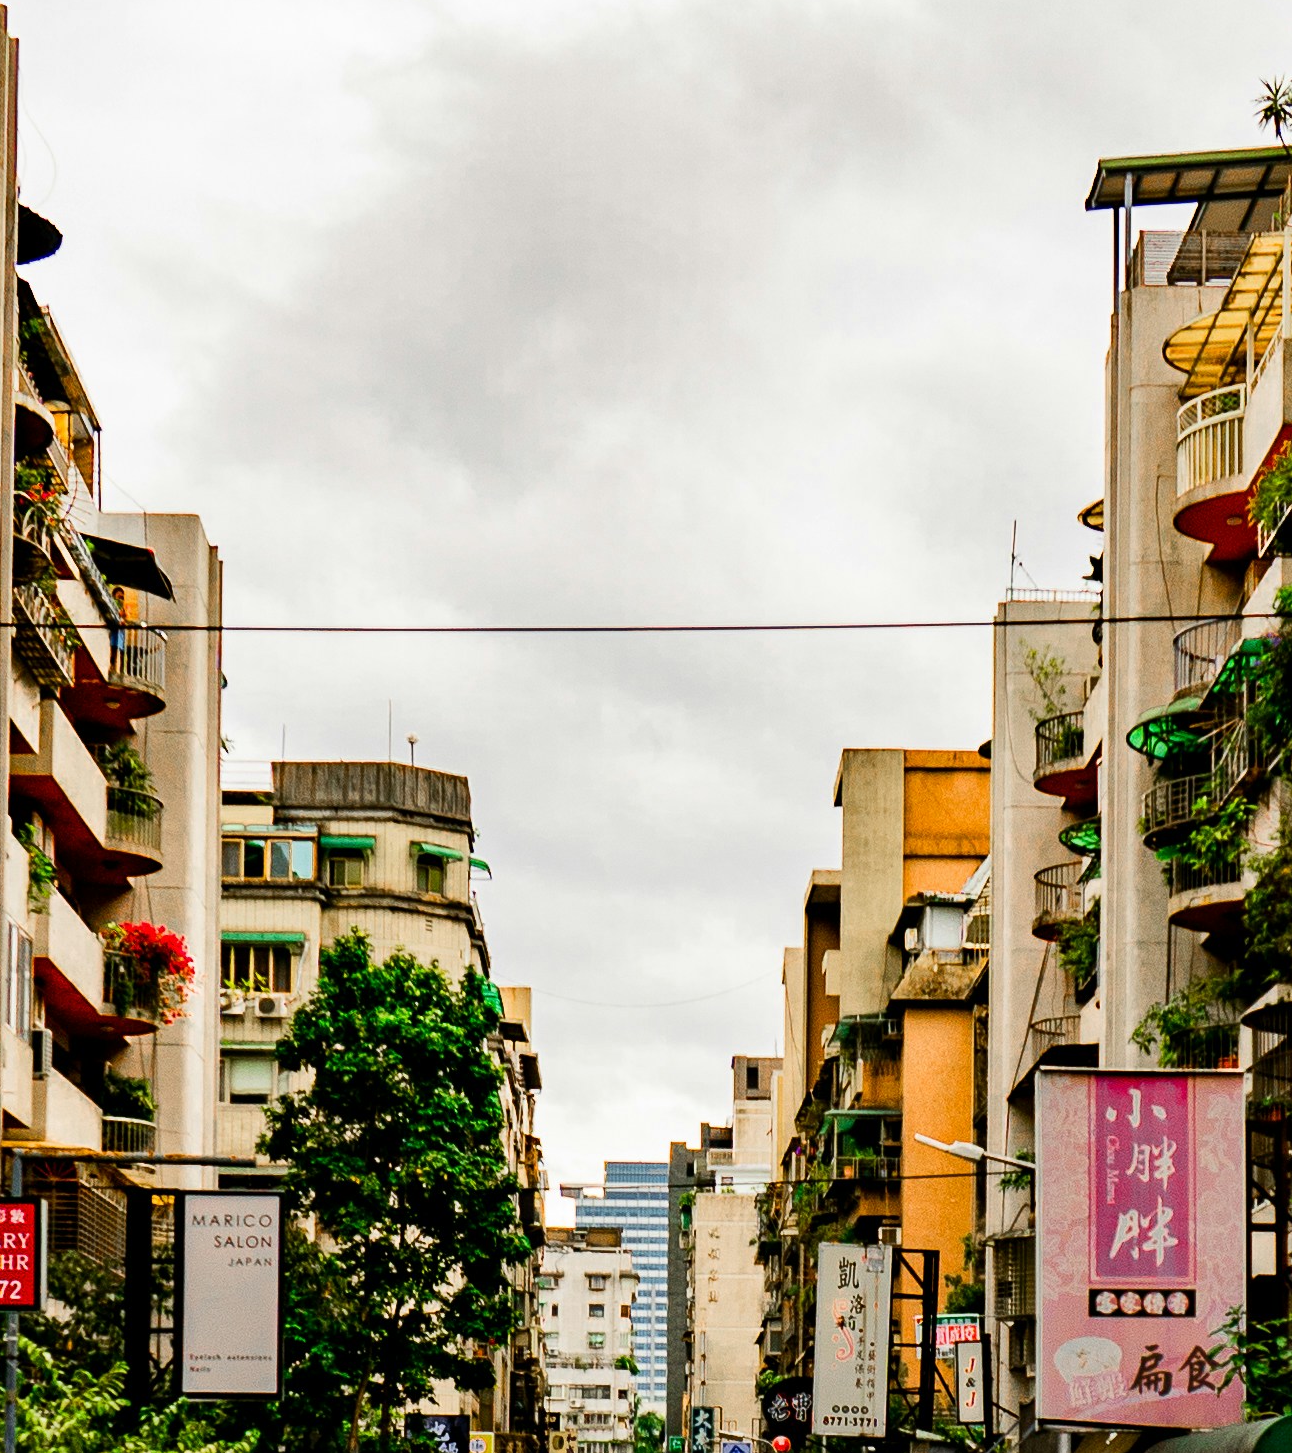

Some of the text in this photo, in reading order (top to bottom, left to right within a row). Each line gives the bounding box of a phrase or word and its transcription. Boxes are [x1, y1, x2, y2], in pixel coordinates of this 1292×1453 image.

[1106, 1088, 1180, 1267] 小胖胖
[192, 1214, 274, 1229] MARICO
[214, 1235, 273, 1249] SALON
[227, 1257, 273, 1268] JAPAN
